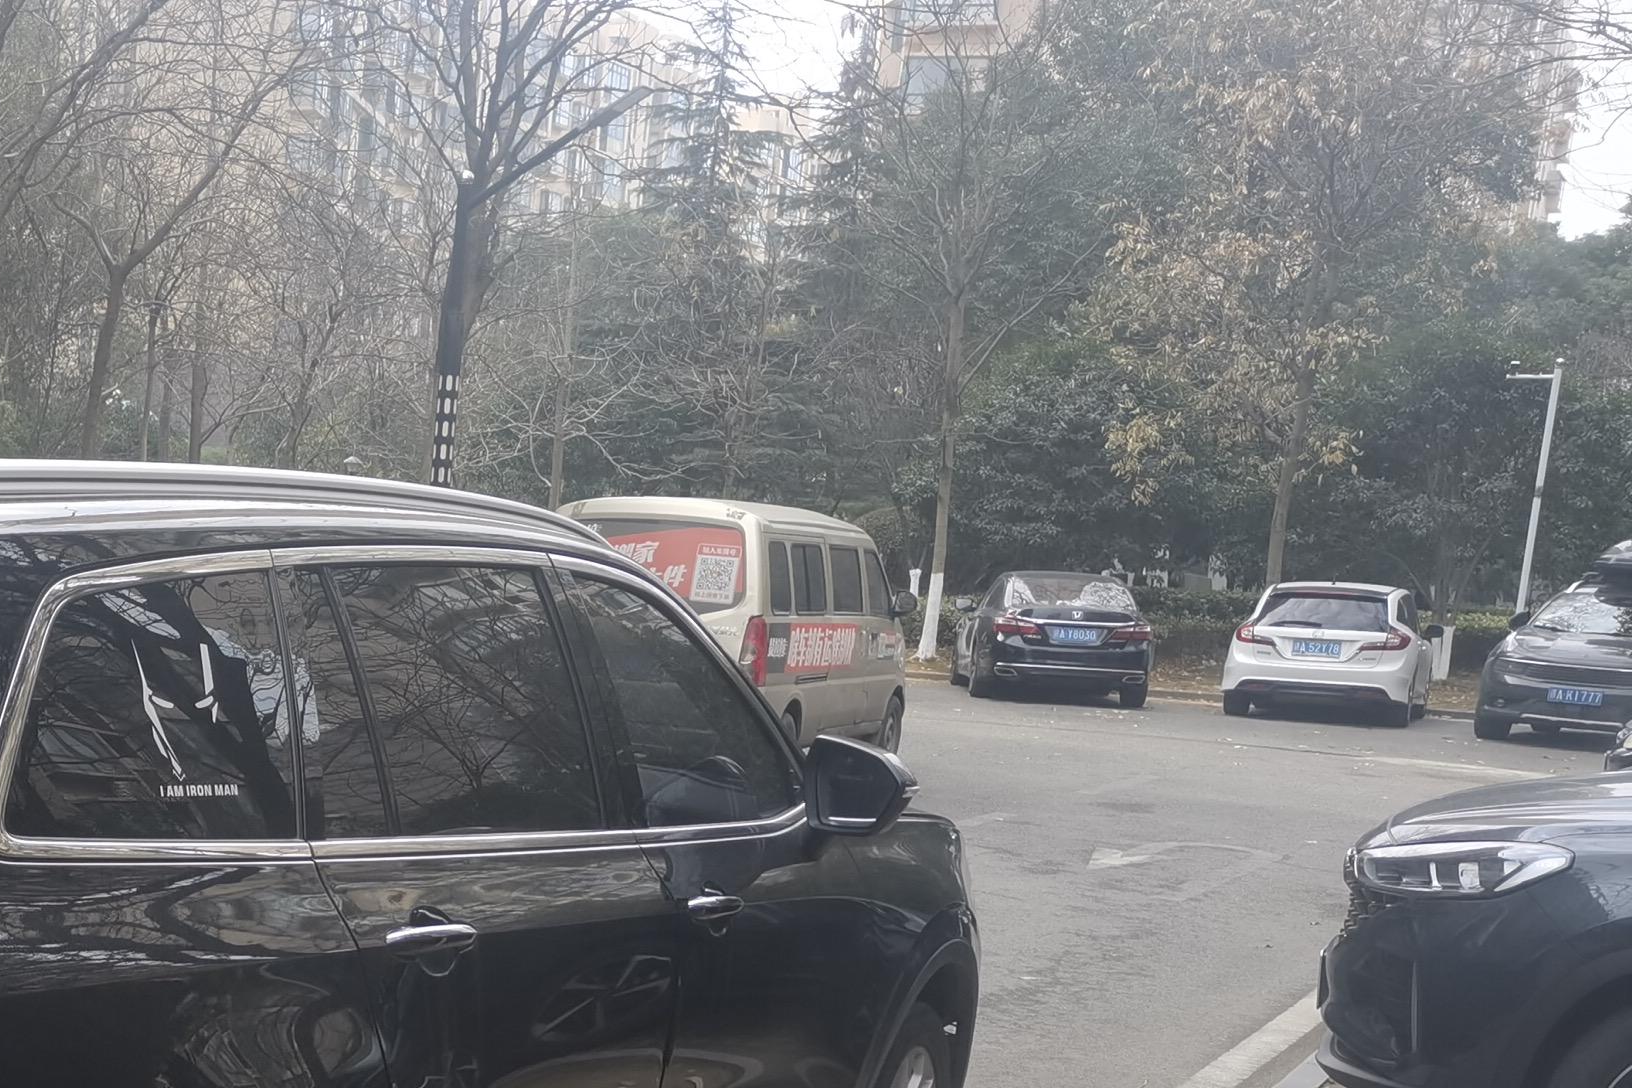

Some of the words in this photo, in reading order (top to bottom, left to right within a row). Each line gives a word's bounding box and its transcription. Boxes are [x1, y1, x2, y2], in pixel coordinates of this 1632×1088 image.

[159, 785, 164, 797] I
[167, 785, 184, 797] AM
[186, 784, 212, 796] IRON
[214, 784, 239, 796] MAN
